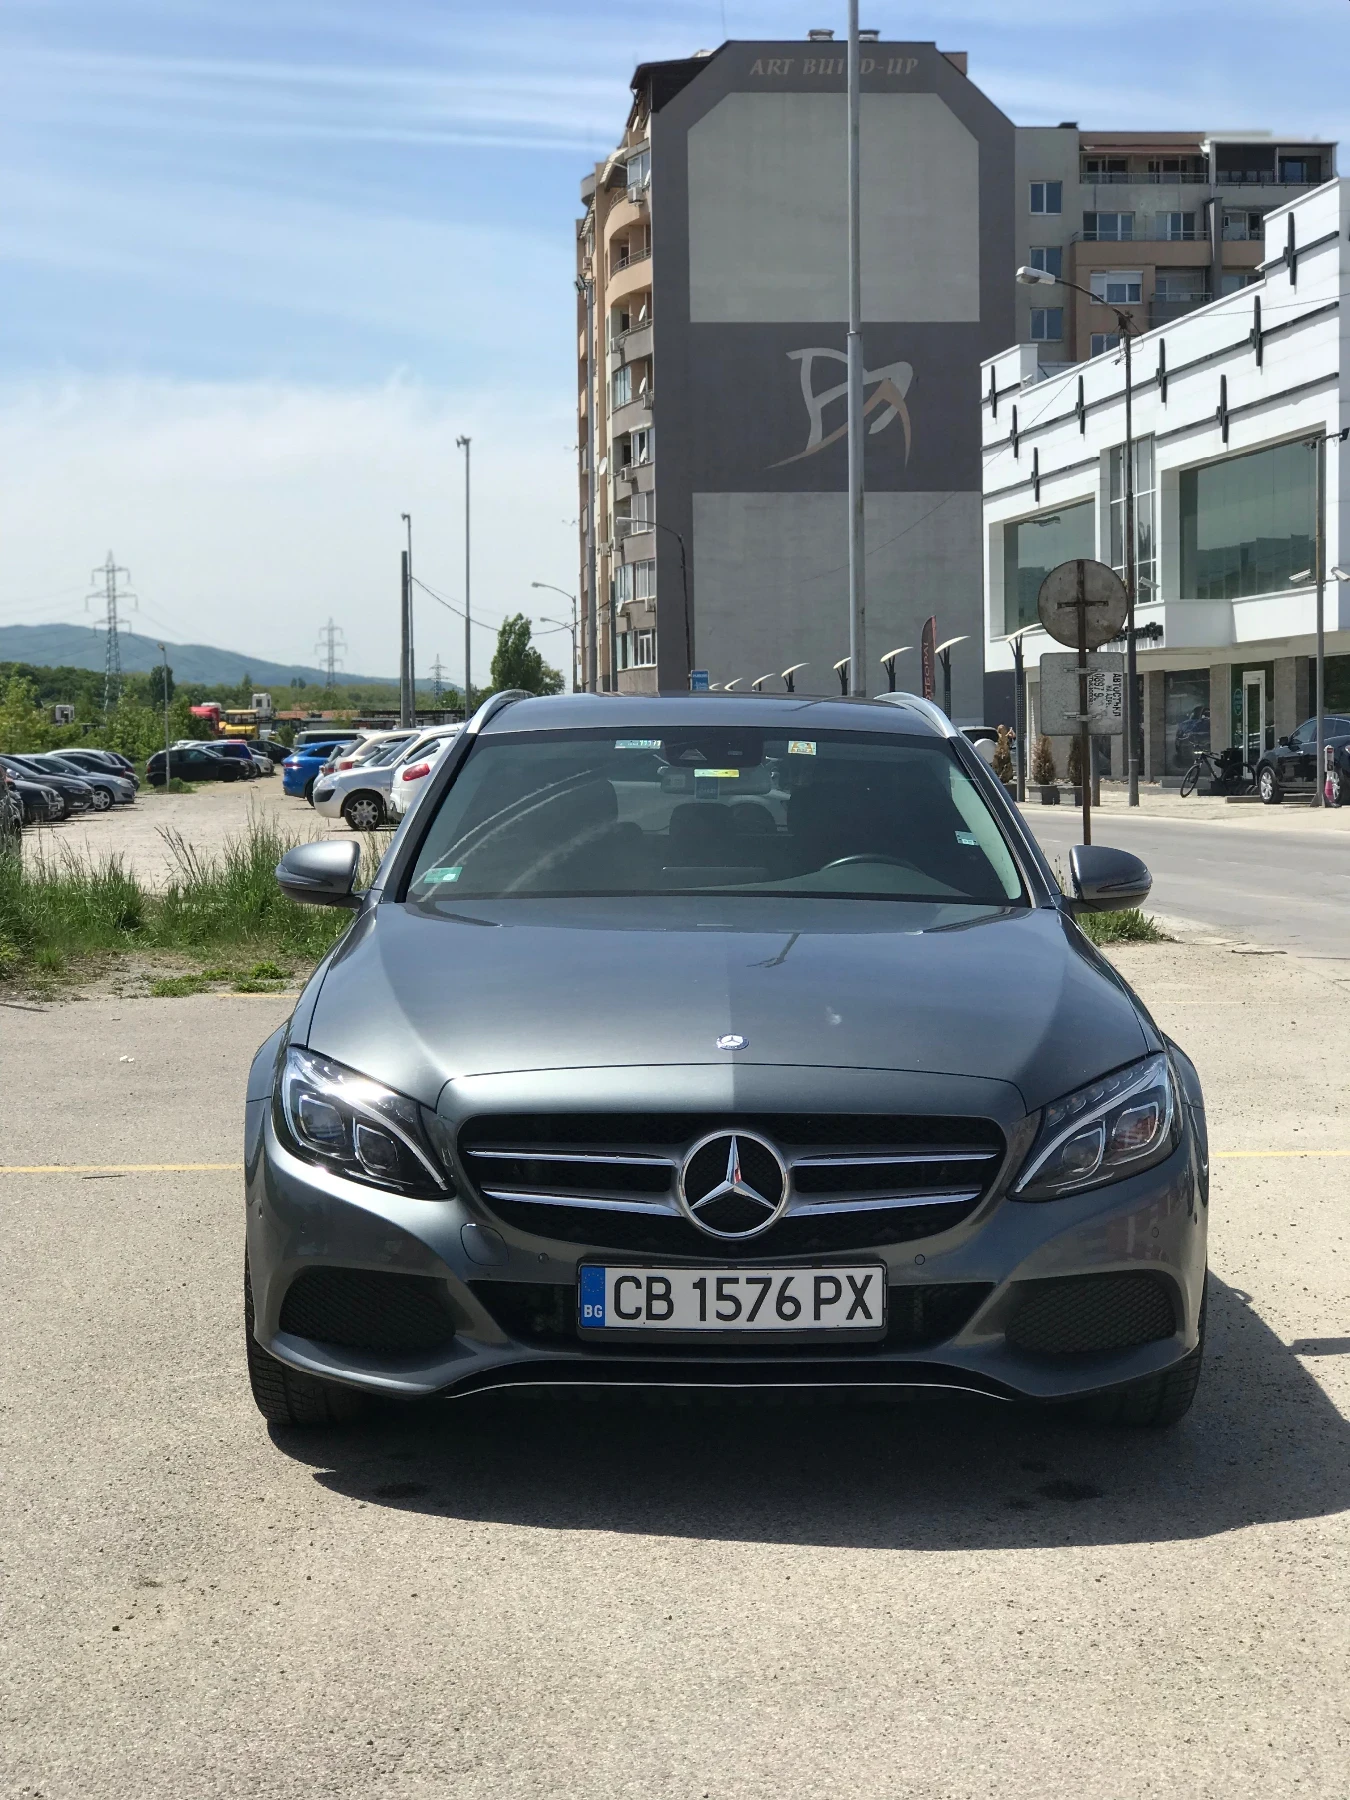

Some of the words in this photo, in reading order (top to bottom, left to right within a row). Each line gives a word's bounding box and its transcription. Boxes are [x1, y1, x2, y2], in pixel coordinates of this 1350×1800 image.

[750, 58, 794, 75] ART
[803, 58, 918, 75] BUID-UP
[613, 1275, 674, 1321] CB
[692, 1277, 802, 1322] 1576
[813, 1274, 873, 1321] PX
[584, 1304, 603, 1318] BG
